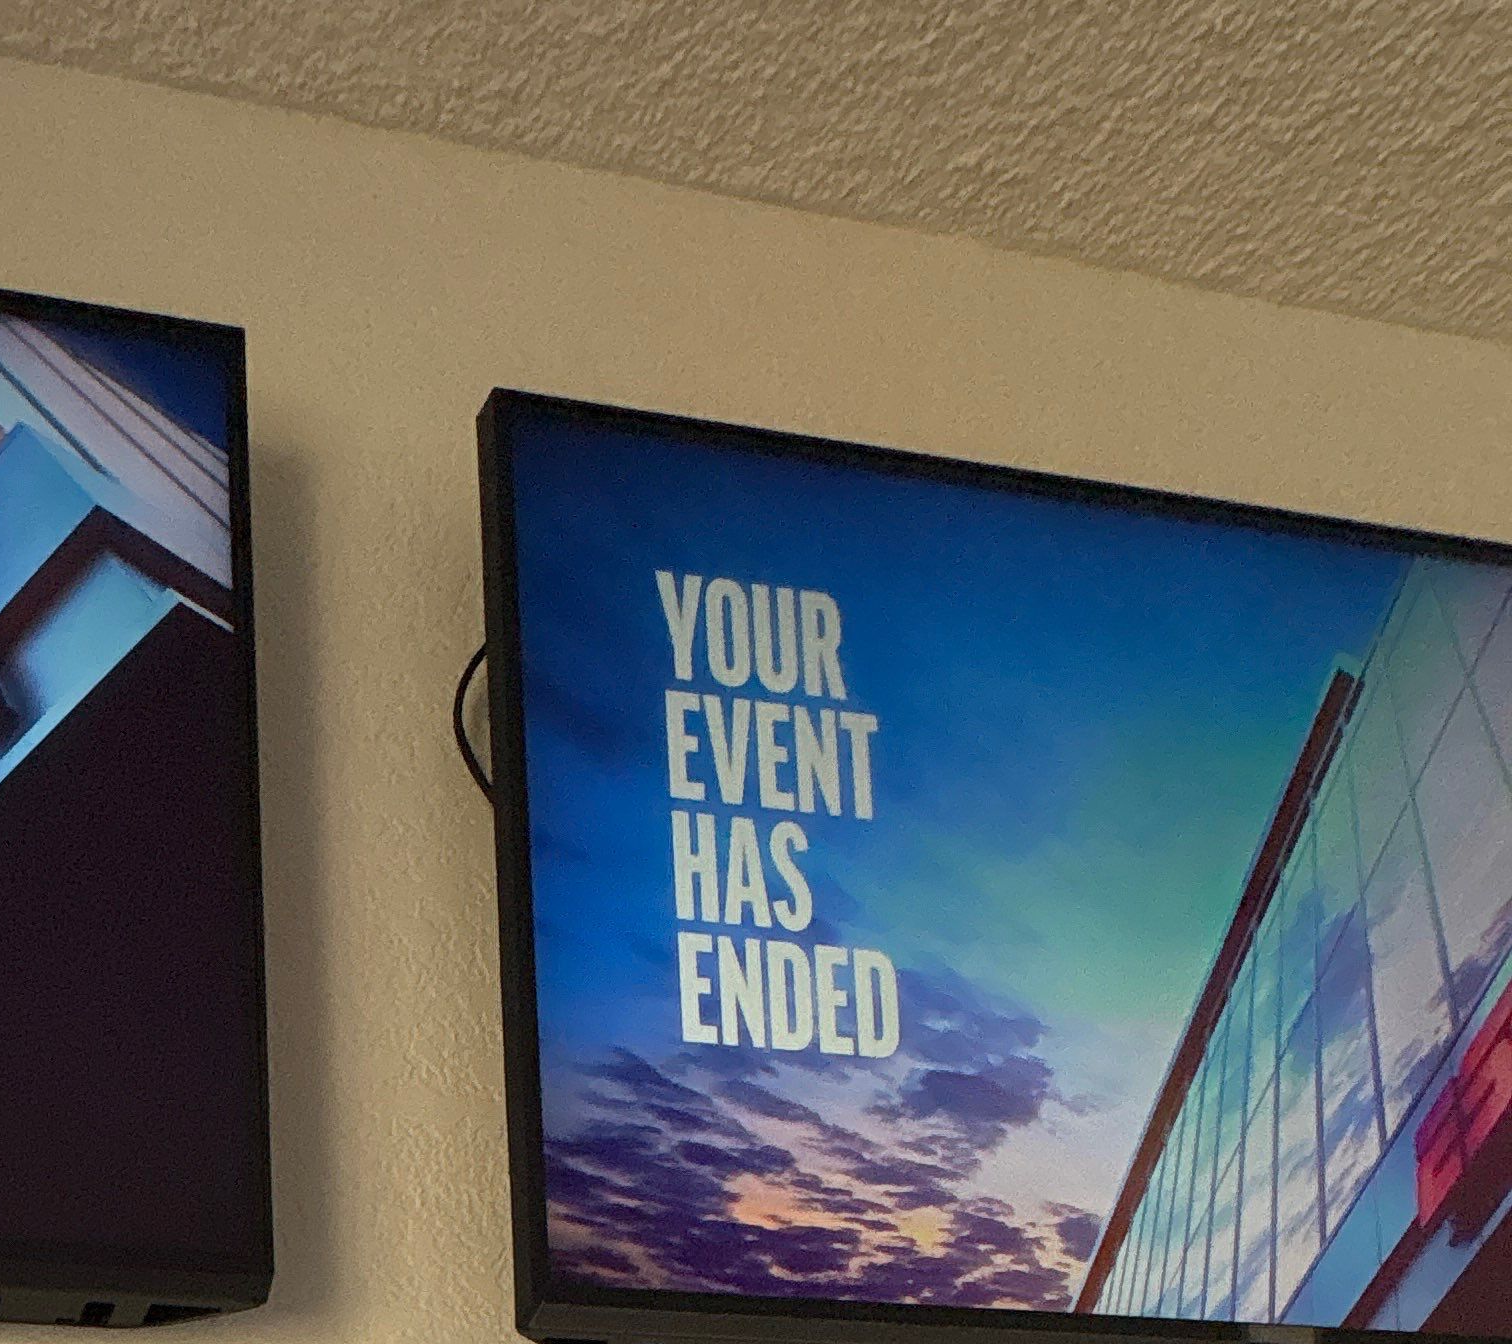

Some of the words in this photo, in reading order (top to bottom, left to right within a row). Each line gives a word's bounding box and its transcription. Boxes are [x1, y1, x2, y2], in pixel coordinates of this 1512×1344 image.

[655, 570, 847, 700] YOUR
[665, 690, 878, 820] EVENT
[672, 810, 813, 932] HAS
[676, 931, 900, 1059] ENDED
